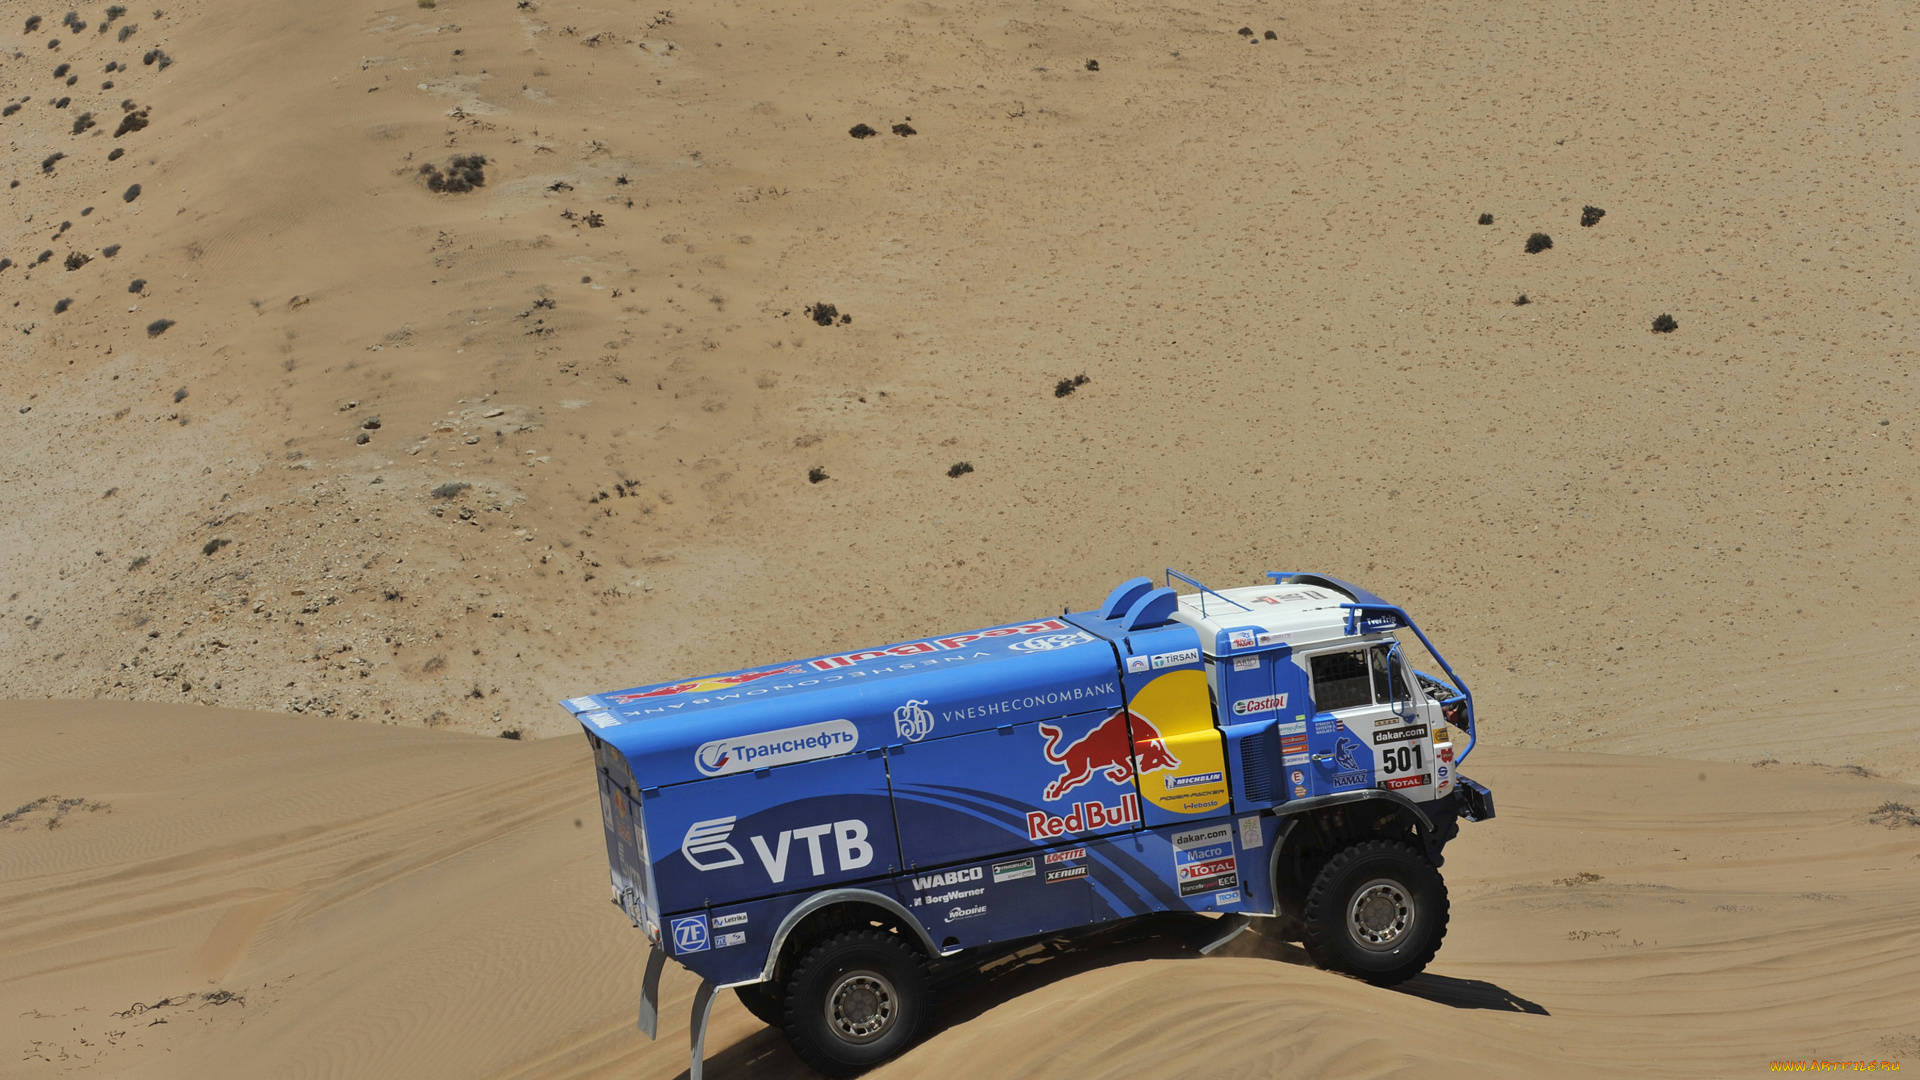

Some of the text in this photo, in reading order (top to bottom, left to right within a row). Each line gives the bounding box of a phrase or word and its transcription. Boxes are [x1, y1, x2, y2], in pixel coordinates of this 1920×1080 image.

[936, 620, 1070, 651] Red
[808, 642, 930, 672] Bull
[943, 682, 1117, 722] VNESHECONOMBANK
[1247, 695, 1284, 712] Castrol
[1376, 728, 1425, 741] dakar.com
[732, 728, 854, 763] Транснефть
[1383, 745, 1422, 774] 501
[1176, 773, 1221, 785] MICHELIN
[1333, 774, 1367, 788] KAMAZ
[1389, 778, 1421, 788] TOTAL
[1159, 789, 1225, 802] POWER-PACKER
[1027, 793, 1140, 840] Red Bull
[1177, 829, 1227, 845] dakar.com
[750, 819, 874, 884] VTB
[1046, 849, 1085, 863] LOCTITE
[1187, 847, 1222, 861] Macro
[1191, 862, 1234, 876] TOTAL
[912, 866, 984, 891] WABCO
[925, 887, 985, 905] BorgWarner
[724, 914, 747, 924] Letrika
[677, 924, 705, 946] ZF
